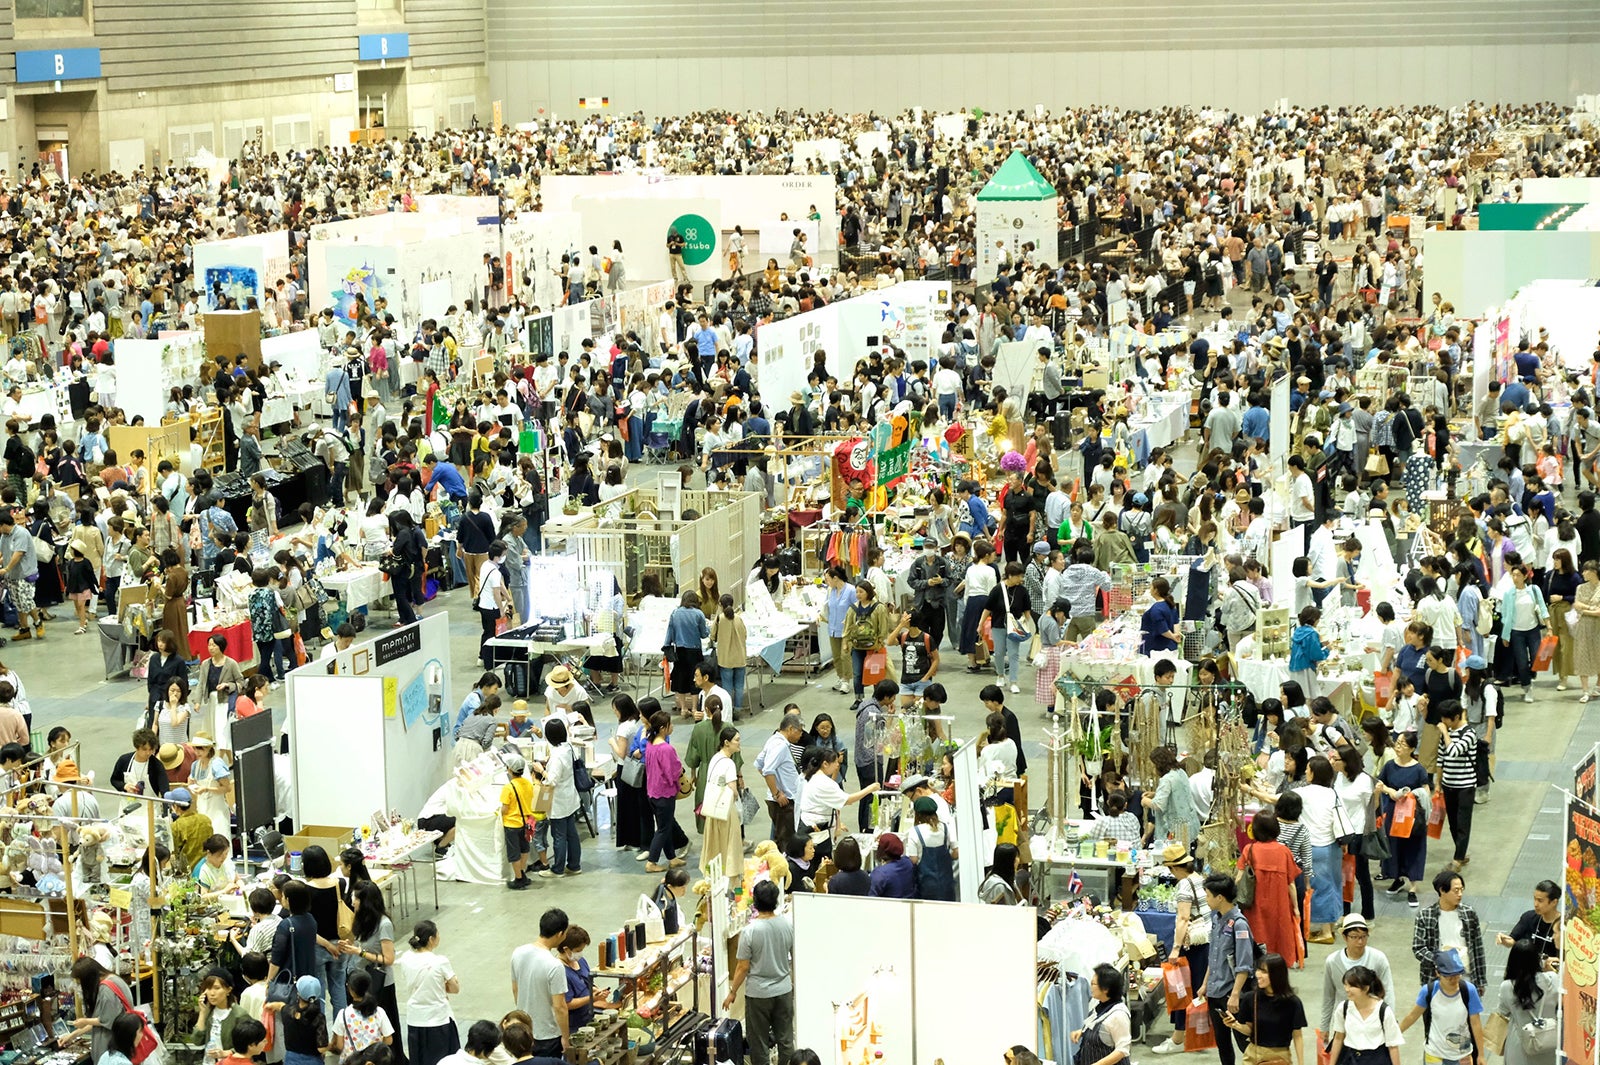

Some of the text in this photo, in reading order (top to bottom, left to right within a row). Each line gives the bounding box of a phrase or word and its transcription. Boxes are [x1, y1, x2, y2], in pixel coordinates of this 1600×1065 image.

[381, 37, 388, 55] B
[54, 54, 64, 75] B
[684, 241, 710, 249] tsuba
[381, 632, 415, 652] memori
[1573, 919, 1591, 939] Have
[1580, 944, 1595, 960] day
